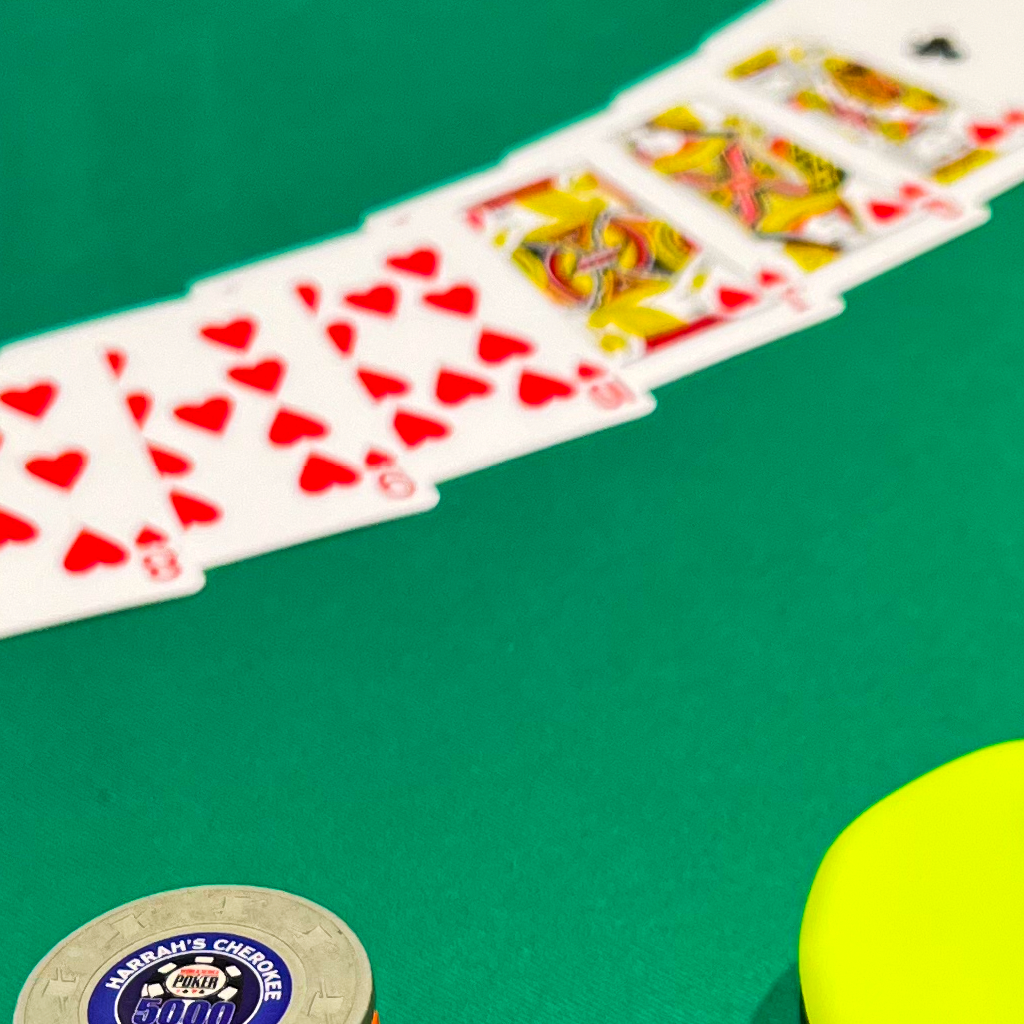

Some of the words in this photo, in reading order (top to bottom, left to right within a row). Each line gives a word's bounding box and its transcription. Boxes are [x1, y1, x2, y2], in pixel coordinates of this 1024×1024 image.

[105, 937, 207, 990] HARRAH'S
[213, 938, 283, 1002] CHEROKEE
[172, 974, 220, 990] POKER
